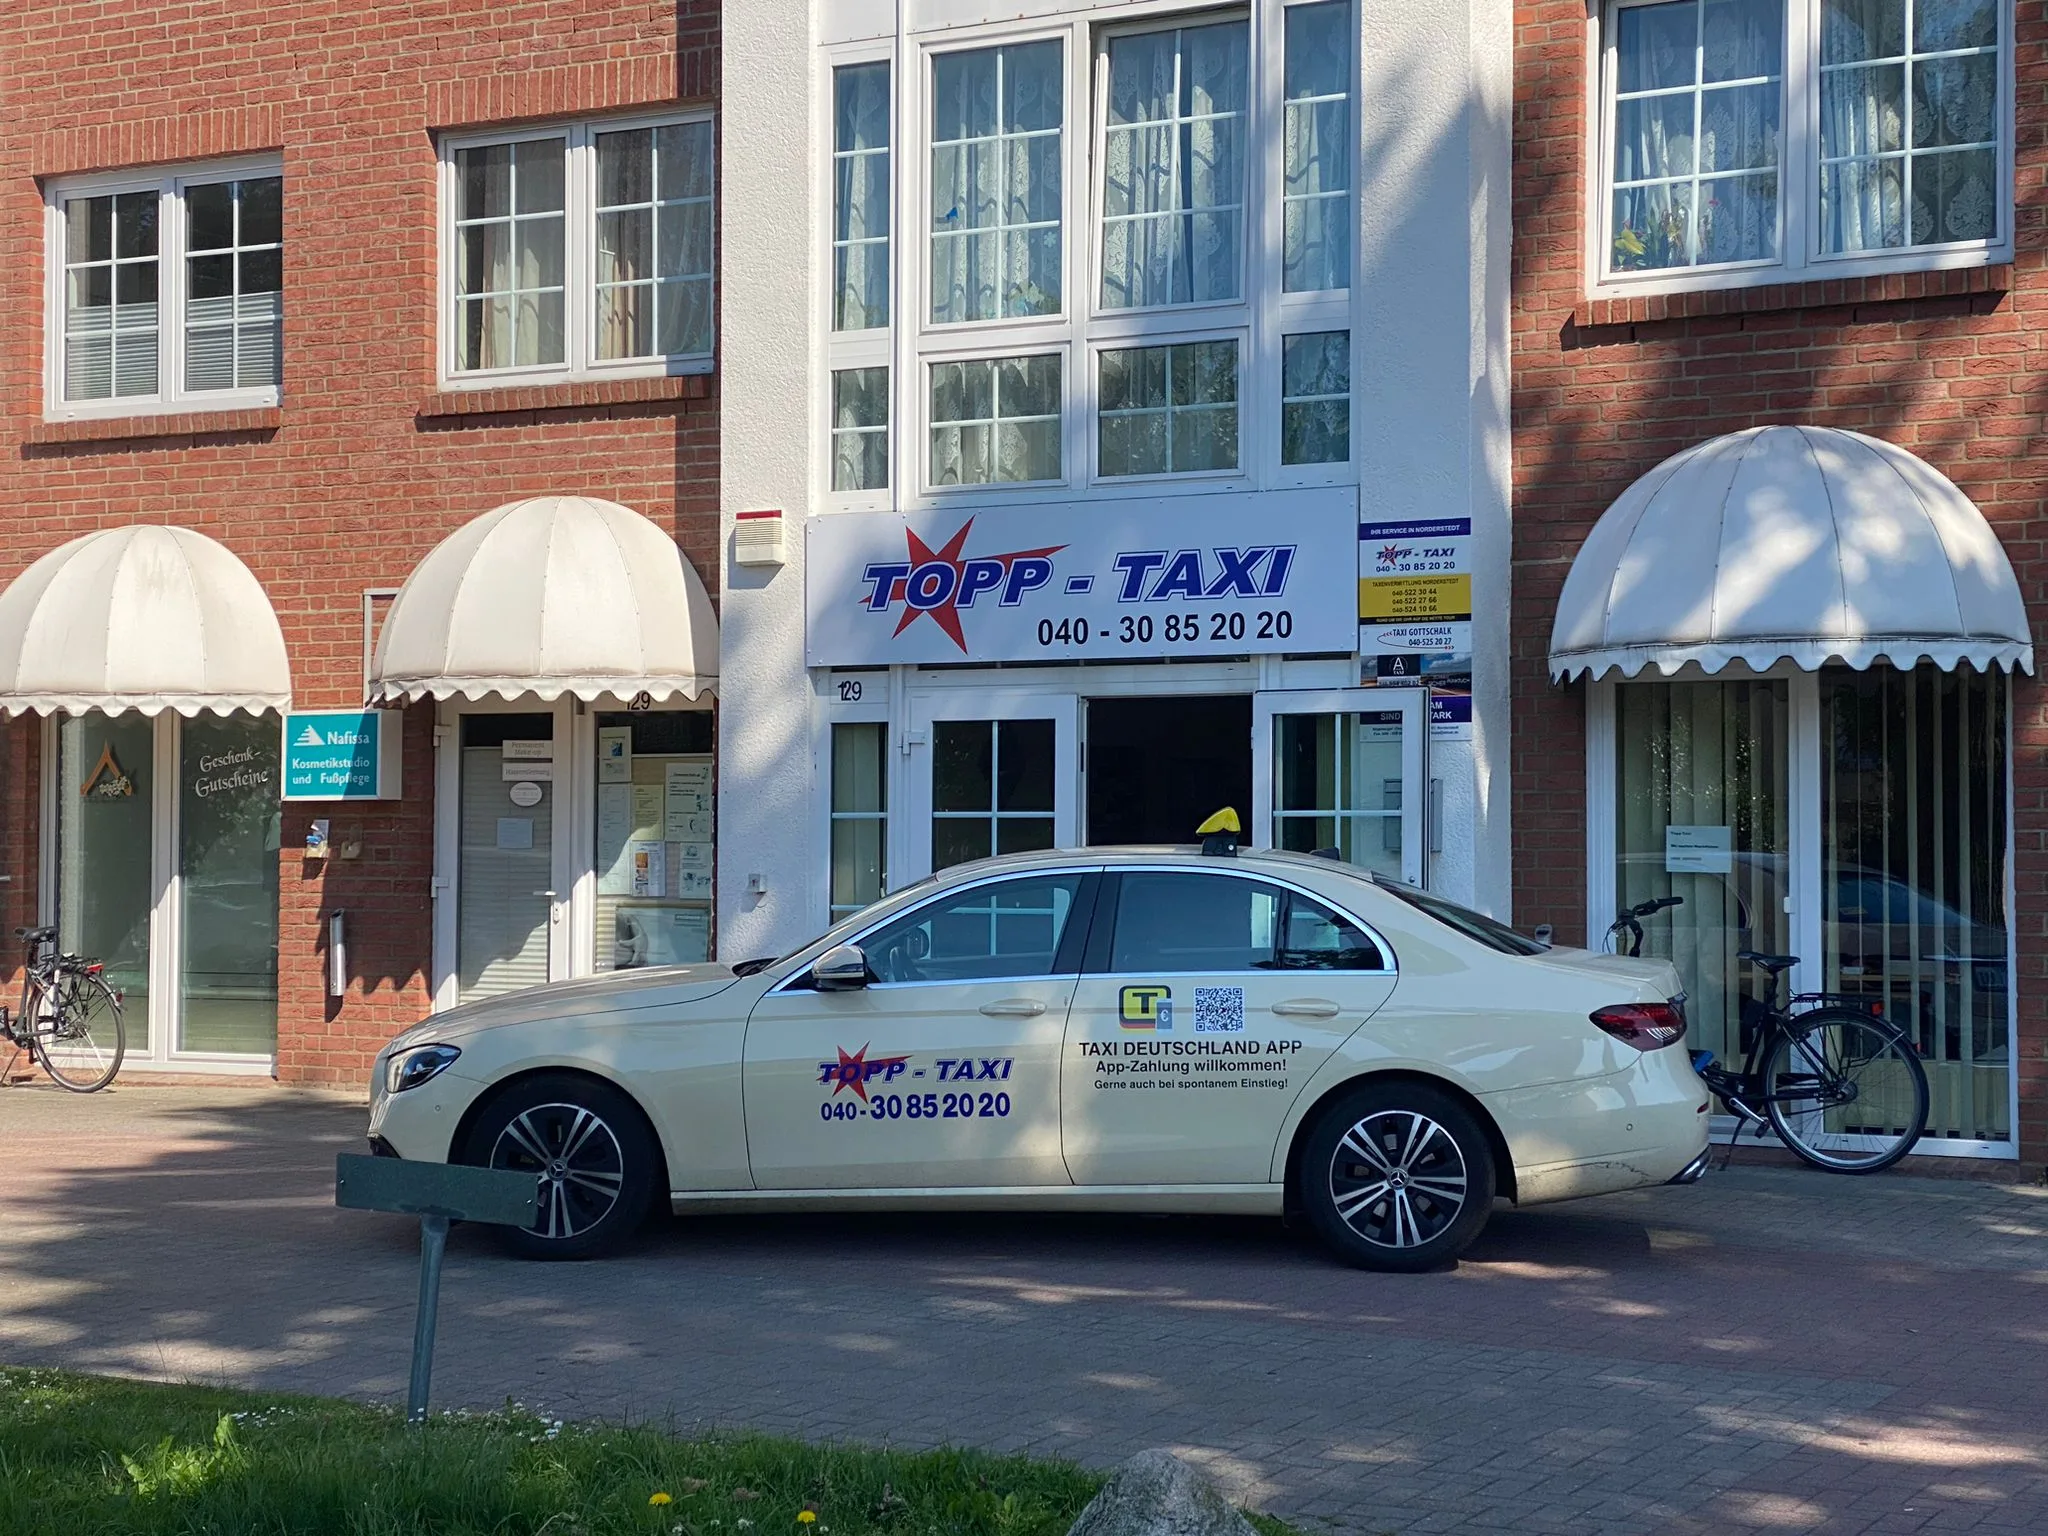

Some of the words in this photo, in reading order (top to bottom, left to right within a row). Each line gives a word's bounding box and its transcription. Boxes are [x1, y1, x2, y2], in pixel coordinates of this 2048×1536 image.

[1382, 527, 1407, 535] SERVICE
[1415, 525, 1460, 533] NORDERSTEDT
[1376, 549, 1412, 560] TOPP
[1423, 547, 1455, 557] TAXI
[1399, 563, 1411, 571] 30
[1428, 562, 1440, 570] 20
[1443, 561, 1455, 569] 20
[862, 557, 1053, 611] TOPP
[1112, 545, 1298, 602] TAXI
[1038, 617, 1088, 646] 040
[1119, 615, 1153, 643] 30
[1165, 613, 1200, 642] 85
[1210, 612, 1246, 641] 20
[1257, 610, 1293, 639] 20
[1409, 627, 1452, 636] GOTTSCHALK
[1409, 638, 1433, 646] 040-525
[1444, 637, 1452, 645] 27
[1393, 657, 1404, 670] A
[837, 680, 862, 701] 129
[1380, 712, 1400, 720] SIND
[327, 731, 370, 745] Nafissa
[200, 748, 261, 773] Geschenk-
[292, 756, 370, 769] Kosmetikstudio
[195, 769, 268, 797] Gutscheine
[292, 773, 312, 784] und
[320, 772, 370, 786] Fußpflege
[1132, 992, 1158, 1014] T
[1079, 1042, 1118, 1056] TAXI
[1123, 1041, 1260, 1056] DEUTSCHLAND
[1266, 1040, 1302, 1054] APP
[817, 1060, 908, 1085] TOPP
[936, 1057, 1015, 1082] TAXI
[1095, 1060, 1189, 1074] App-Zahlung
[1194, 1059, 1286, 1072] willkommen!
[1094, 1080, 1126, 1090] Gerne
[1129, 1079, 1156, 1089] auch
[1159, 1079, 1175, 1089] bei
[1178, 1079, 1238, 1090] spontanem
[1241, 1078, 1288, 1090] Einstieg!
[906, 1094, 938, 1119] 85
[942, 1093, 975, 1118] 20
[978, 1092, 1011, 1117] 20
